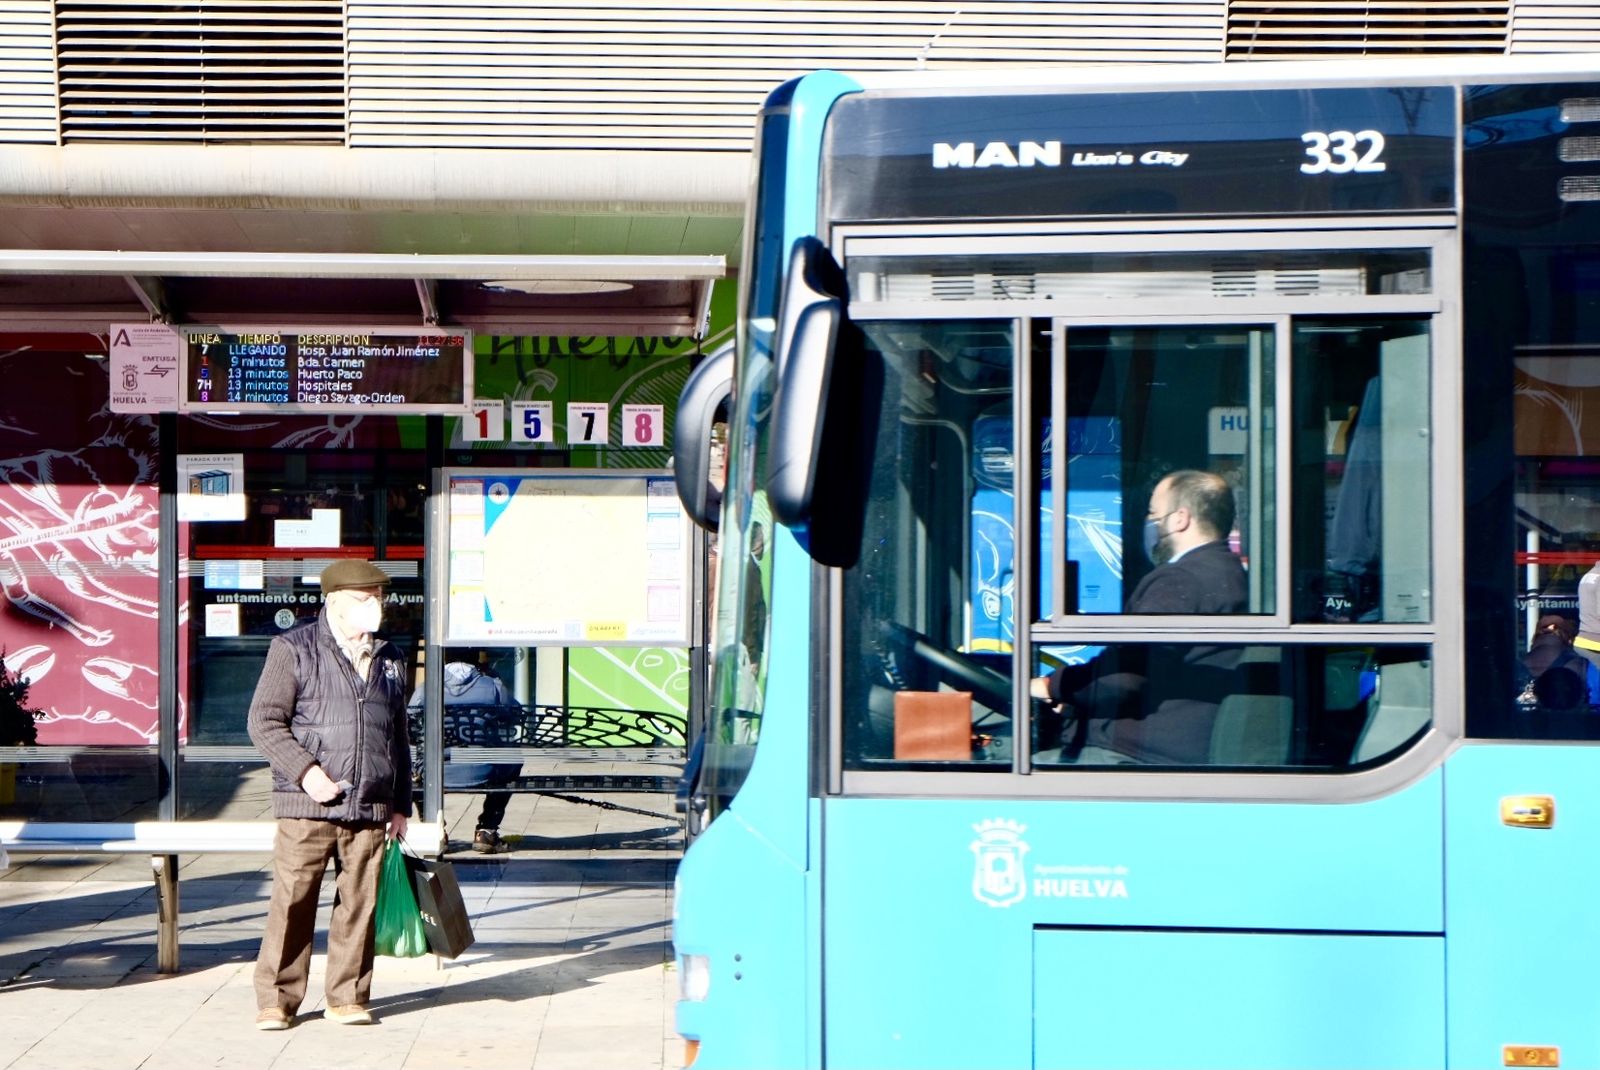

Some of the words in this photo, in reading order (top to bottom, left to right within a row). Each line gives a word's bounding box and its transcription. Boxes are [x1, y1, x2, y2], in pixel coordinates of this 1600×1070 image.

[932, 140, 1062, 168] MAN
[1071, 151, 1134, 167] Lion's
[1139, 150, 1190, 167] City
[1300, 129, 1387, 175] 332
[237, 334, 281, 344] TIEMPO
[201, 345, 209, 355] 7
[229, 345, 287, 355] LLEGANDO
[297, 345, 328, 358] Hosp.
[330, 345, 355, 357] Juan
[357, 345, 395, 357] Ramón
[396, 345, 440, 357] Jiménez
[201, 356, 209, 366] 1
[231, 356, 239, 367] 9
[241, 356, 286, 367] minutos
[297, 357, 321, 368] Bda.
[323, 357, 365, 368] Carmen
[201, 368, 209, 378] 5
[228, 368, 242, 379] 13
[245, 368, 289, 378] minutos
[297, 369, 335, 379] Huerto
[337, 369, 363, 379] Paco
[197, 379, 213, 390] 7H
[228, 380, 242, 390] 13
[245, 380, 289, 390] minutos
[297, 380, 353, 392] Hospitales
[112, 396, 147, 404] HUELVA
[201, 392, 209, 402] 8
[227, 392, 241, 402] 14
[245, 392, 289, 402] minutos
[297, 392, 329, 404] Diego
[330, 392, 405, 405] Sayago-Orden
[475, 409, 488, 438] 1
[524, 409, 541, 439] 5
[581, 412, 595, 441] 7
[634, 413, 653, 443] 8
[216, 592, 297, 604] untamiento
[299, 592, 317, 604] de
[1034, 879, 1129, 898] HUELVA
